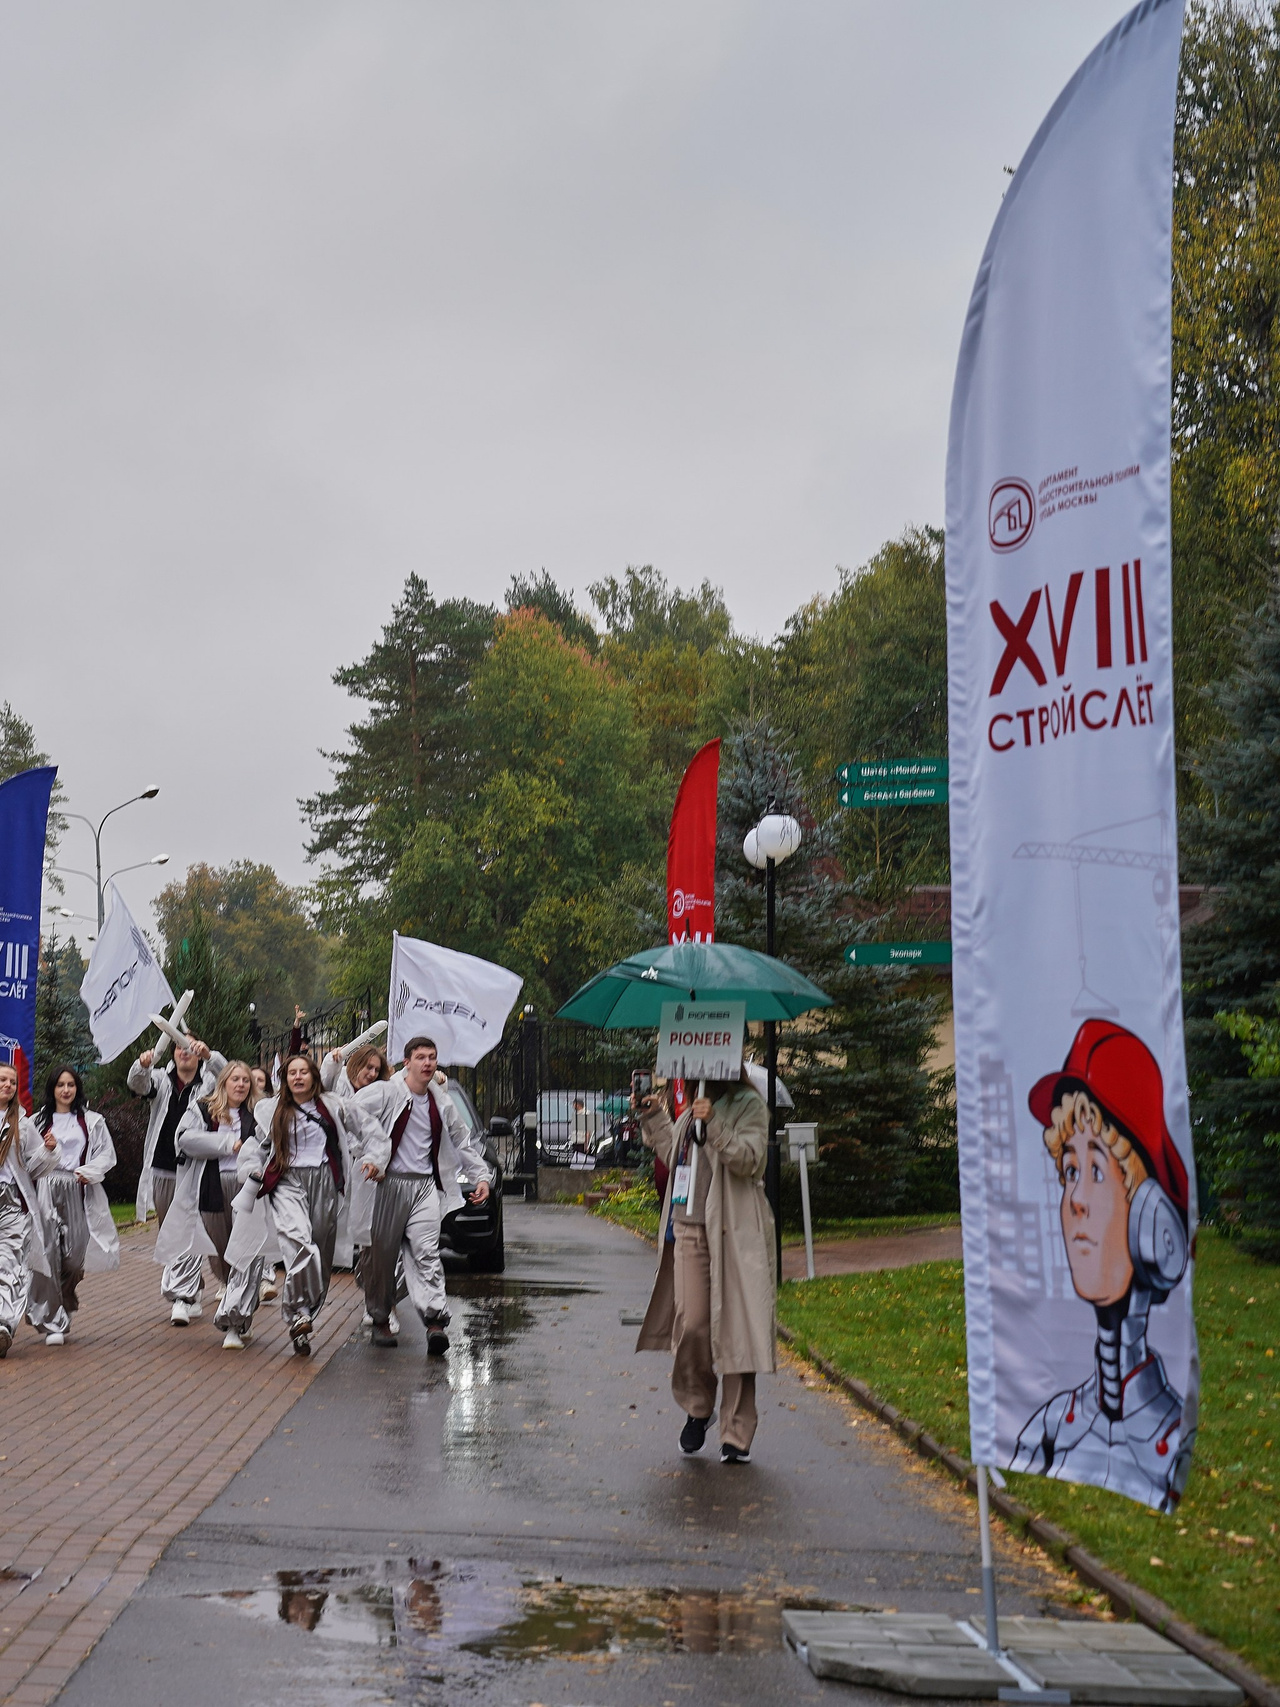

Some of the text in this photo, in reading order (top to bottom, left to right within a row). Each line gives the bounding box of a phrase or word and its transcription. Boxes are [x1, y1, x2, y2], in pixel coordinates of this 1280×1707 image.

[1058, 493, 1098, 511] МОСКВЫ
[988, 558, 1148, 698] XVIII
[988, 675, 1155, 752] СТРОЙСЛЁТ
[889, 948, 923, 959] Экопарк
[669, 1031, 732, 1046] PIONEER
